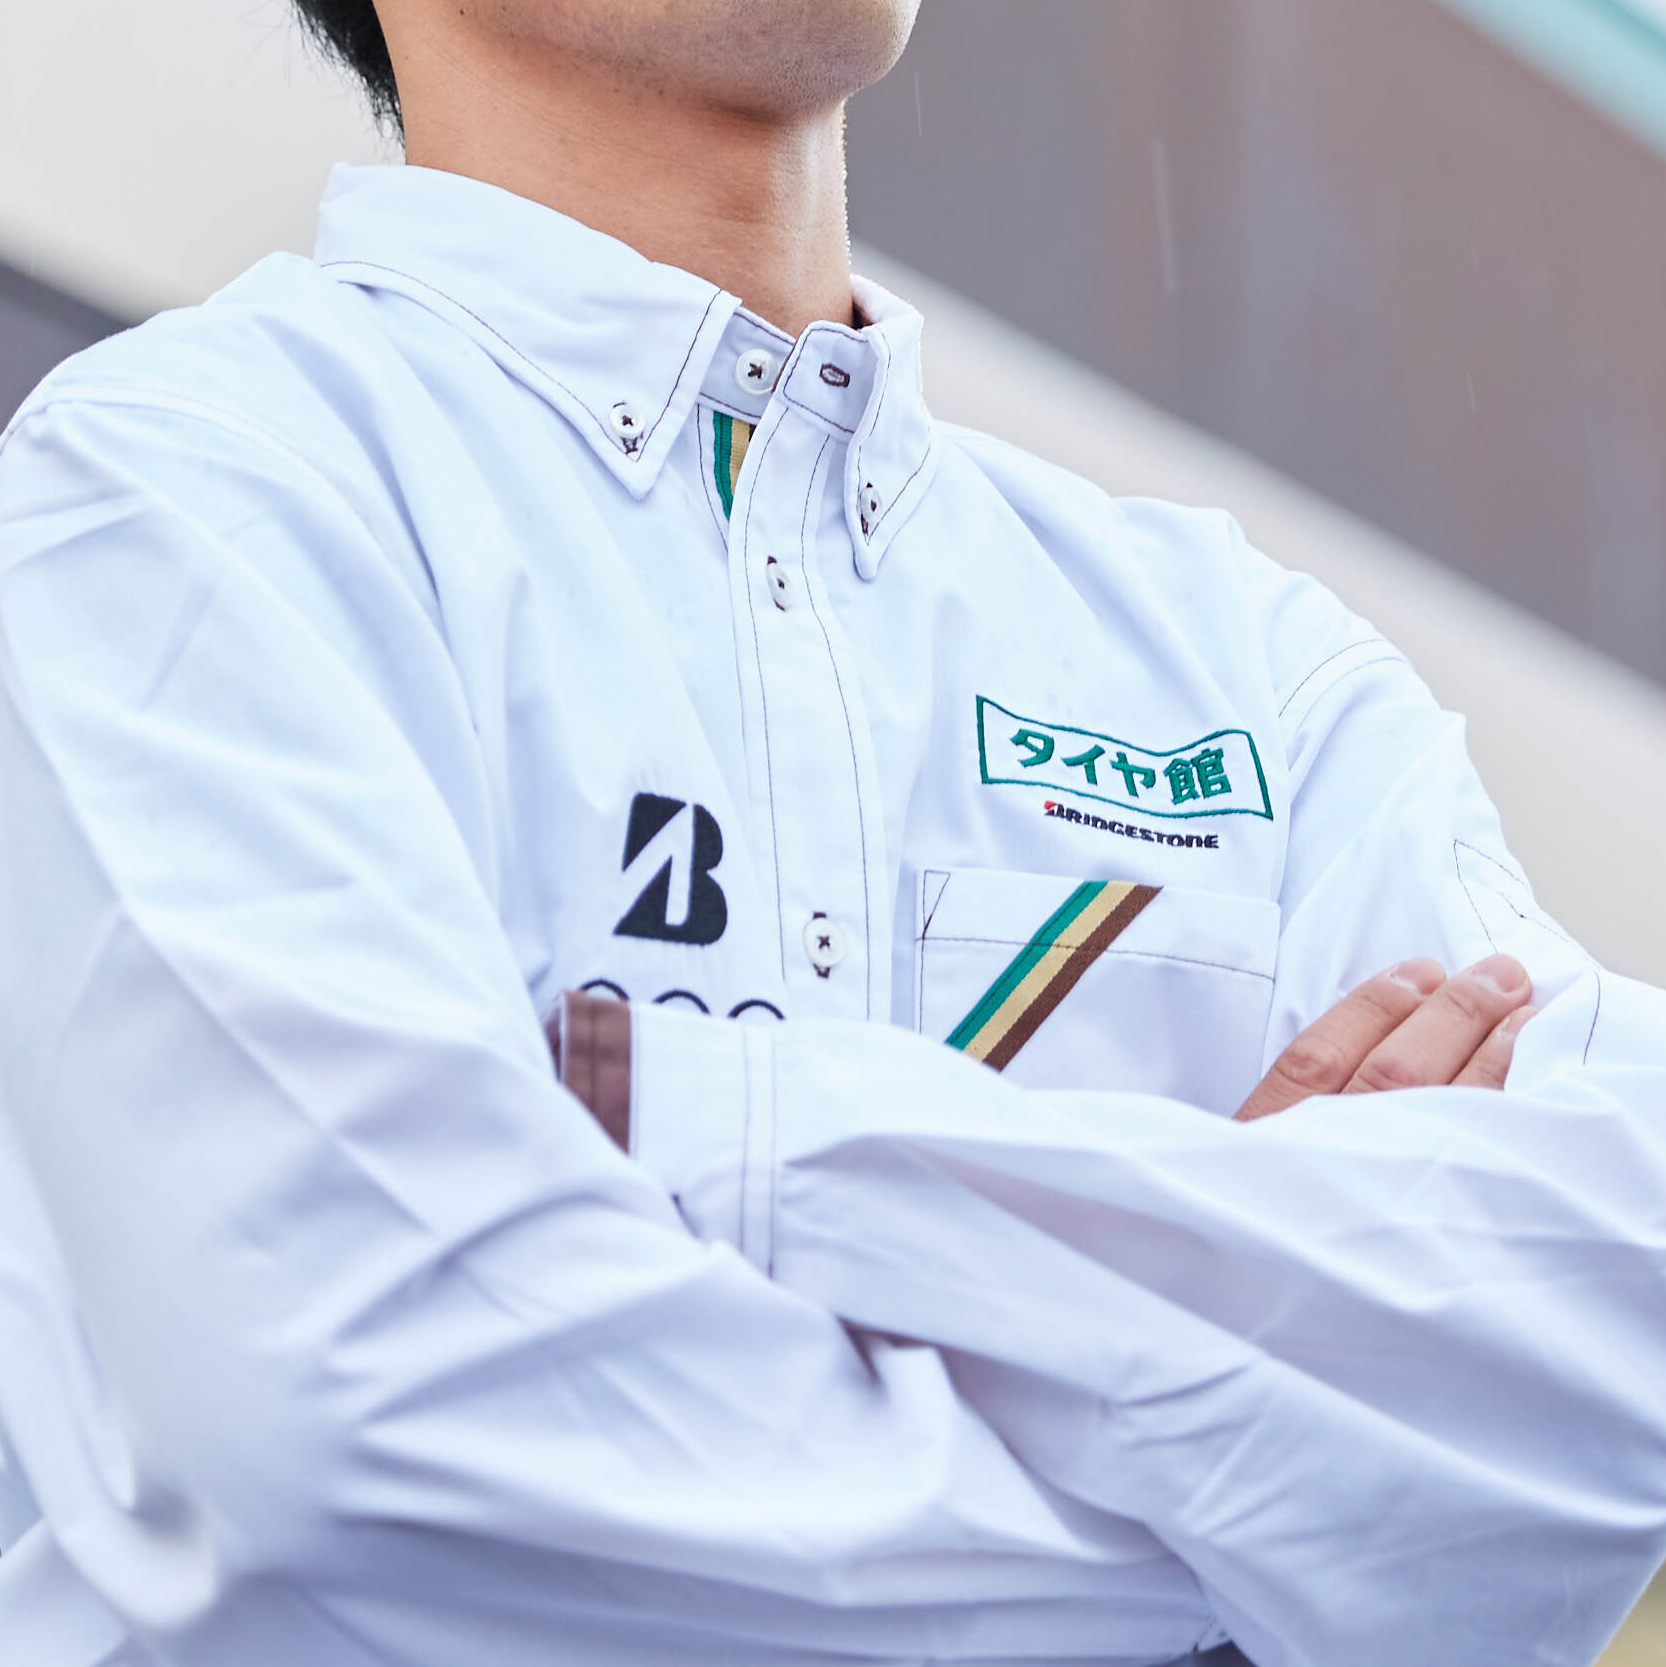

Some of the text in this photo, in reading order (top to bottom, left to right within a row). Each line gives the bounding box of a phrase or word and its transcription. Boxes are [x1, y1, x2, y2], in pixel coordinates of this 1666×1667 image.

[1009, 728, 1233, 806] タイヤ館
[1043, 799, 1220, 850] BRIDGESTONE
